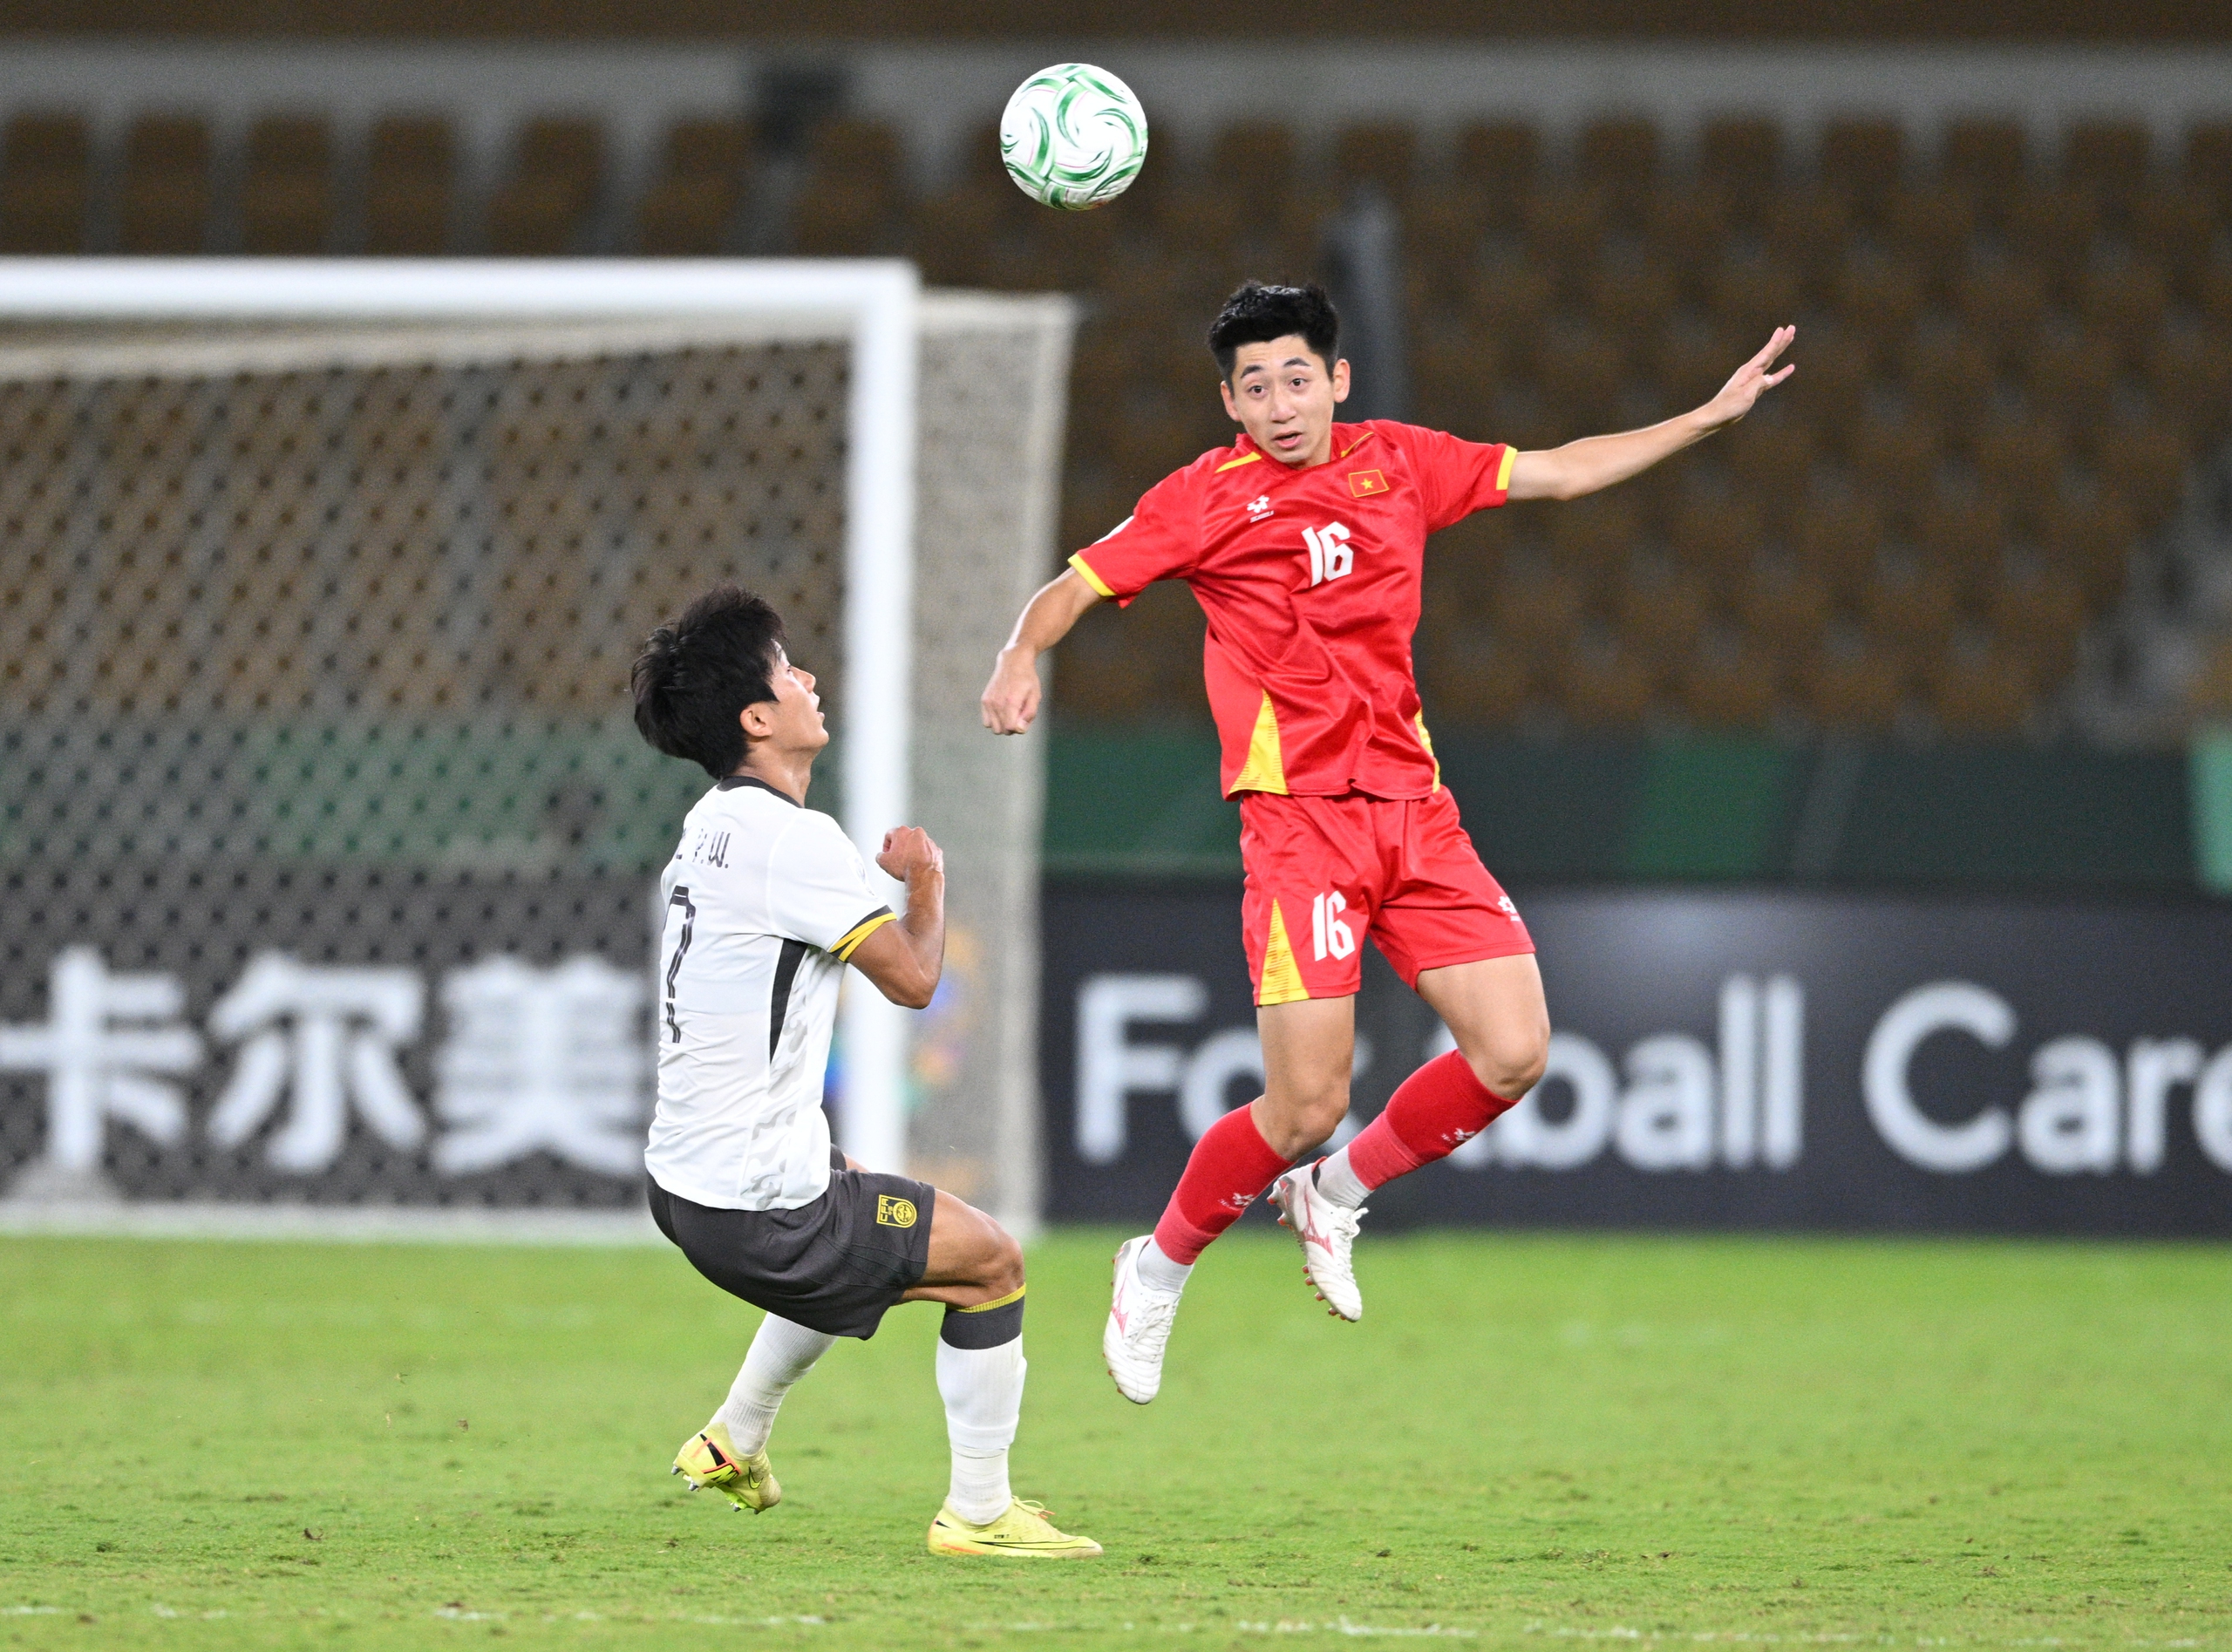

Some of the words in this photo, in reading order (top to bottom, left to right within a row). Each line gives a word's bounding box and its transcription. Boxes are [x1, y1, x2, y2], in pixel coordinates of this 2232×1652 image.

[1301, 520, 1355, 588] 16
[1311, 890, 1356, 962] 16
[0, 946, 650, 1177] 卡尔美
